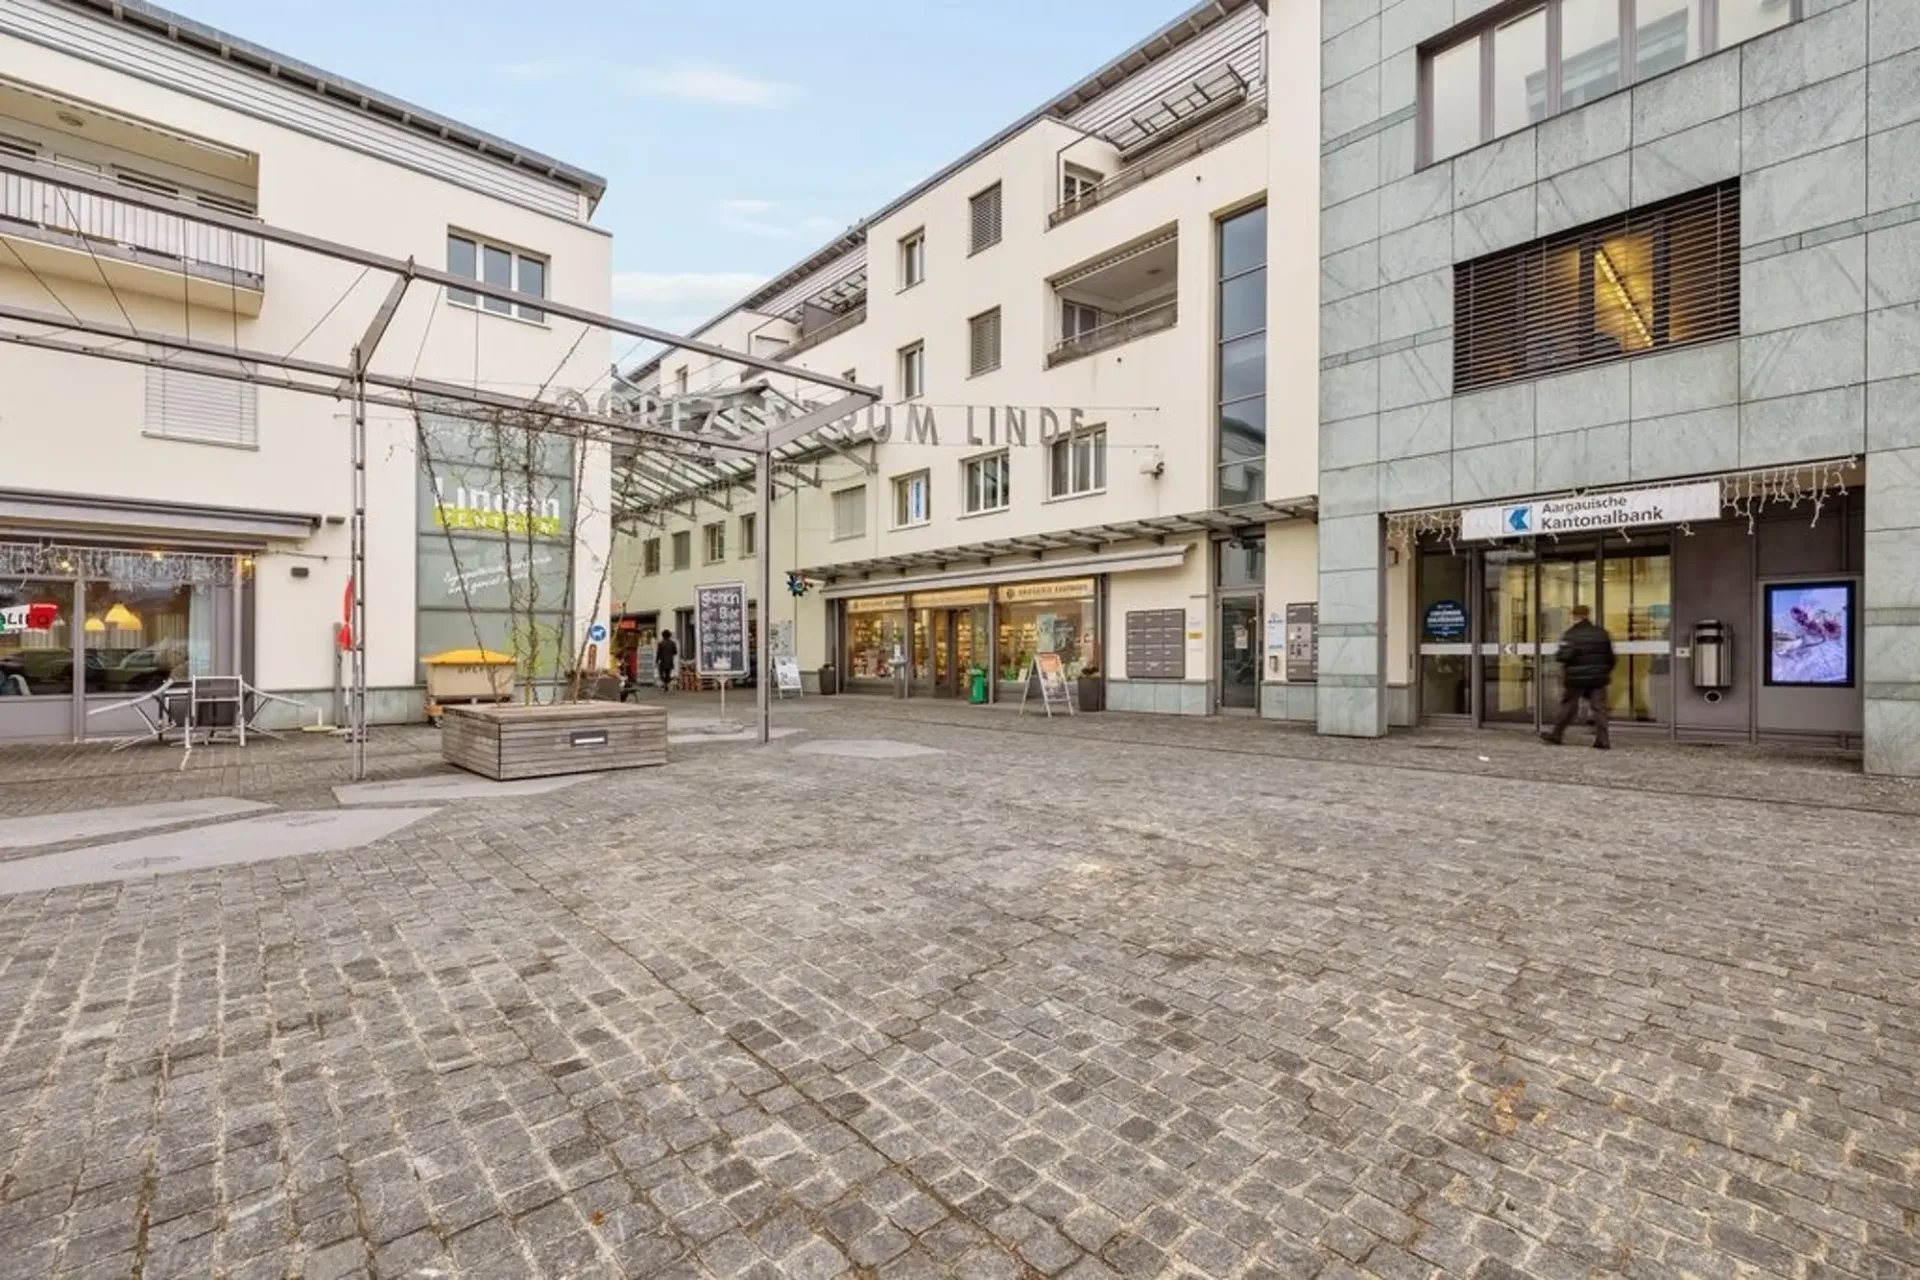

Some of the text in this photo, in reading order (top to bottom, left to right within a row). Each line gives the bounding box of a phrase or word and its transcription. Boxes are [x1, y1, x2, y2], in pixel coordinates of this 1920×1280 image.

[967, 404, 1085, 447] LINDE
[434, 477, 560, 520] Linden
[1541, 494, 1628, 514] Aargauische
[1541, 506, 1664, 530] Kantonalbank
